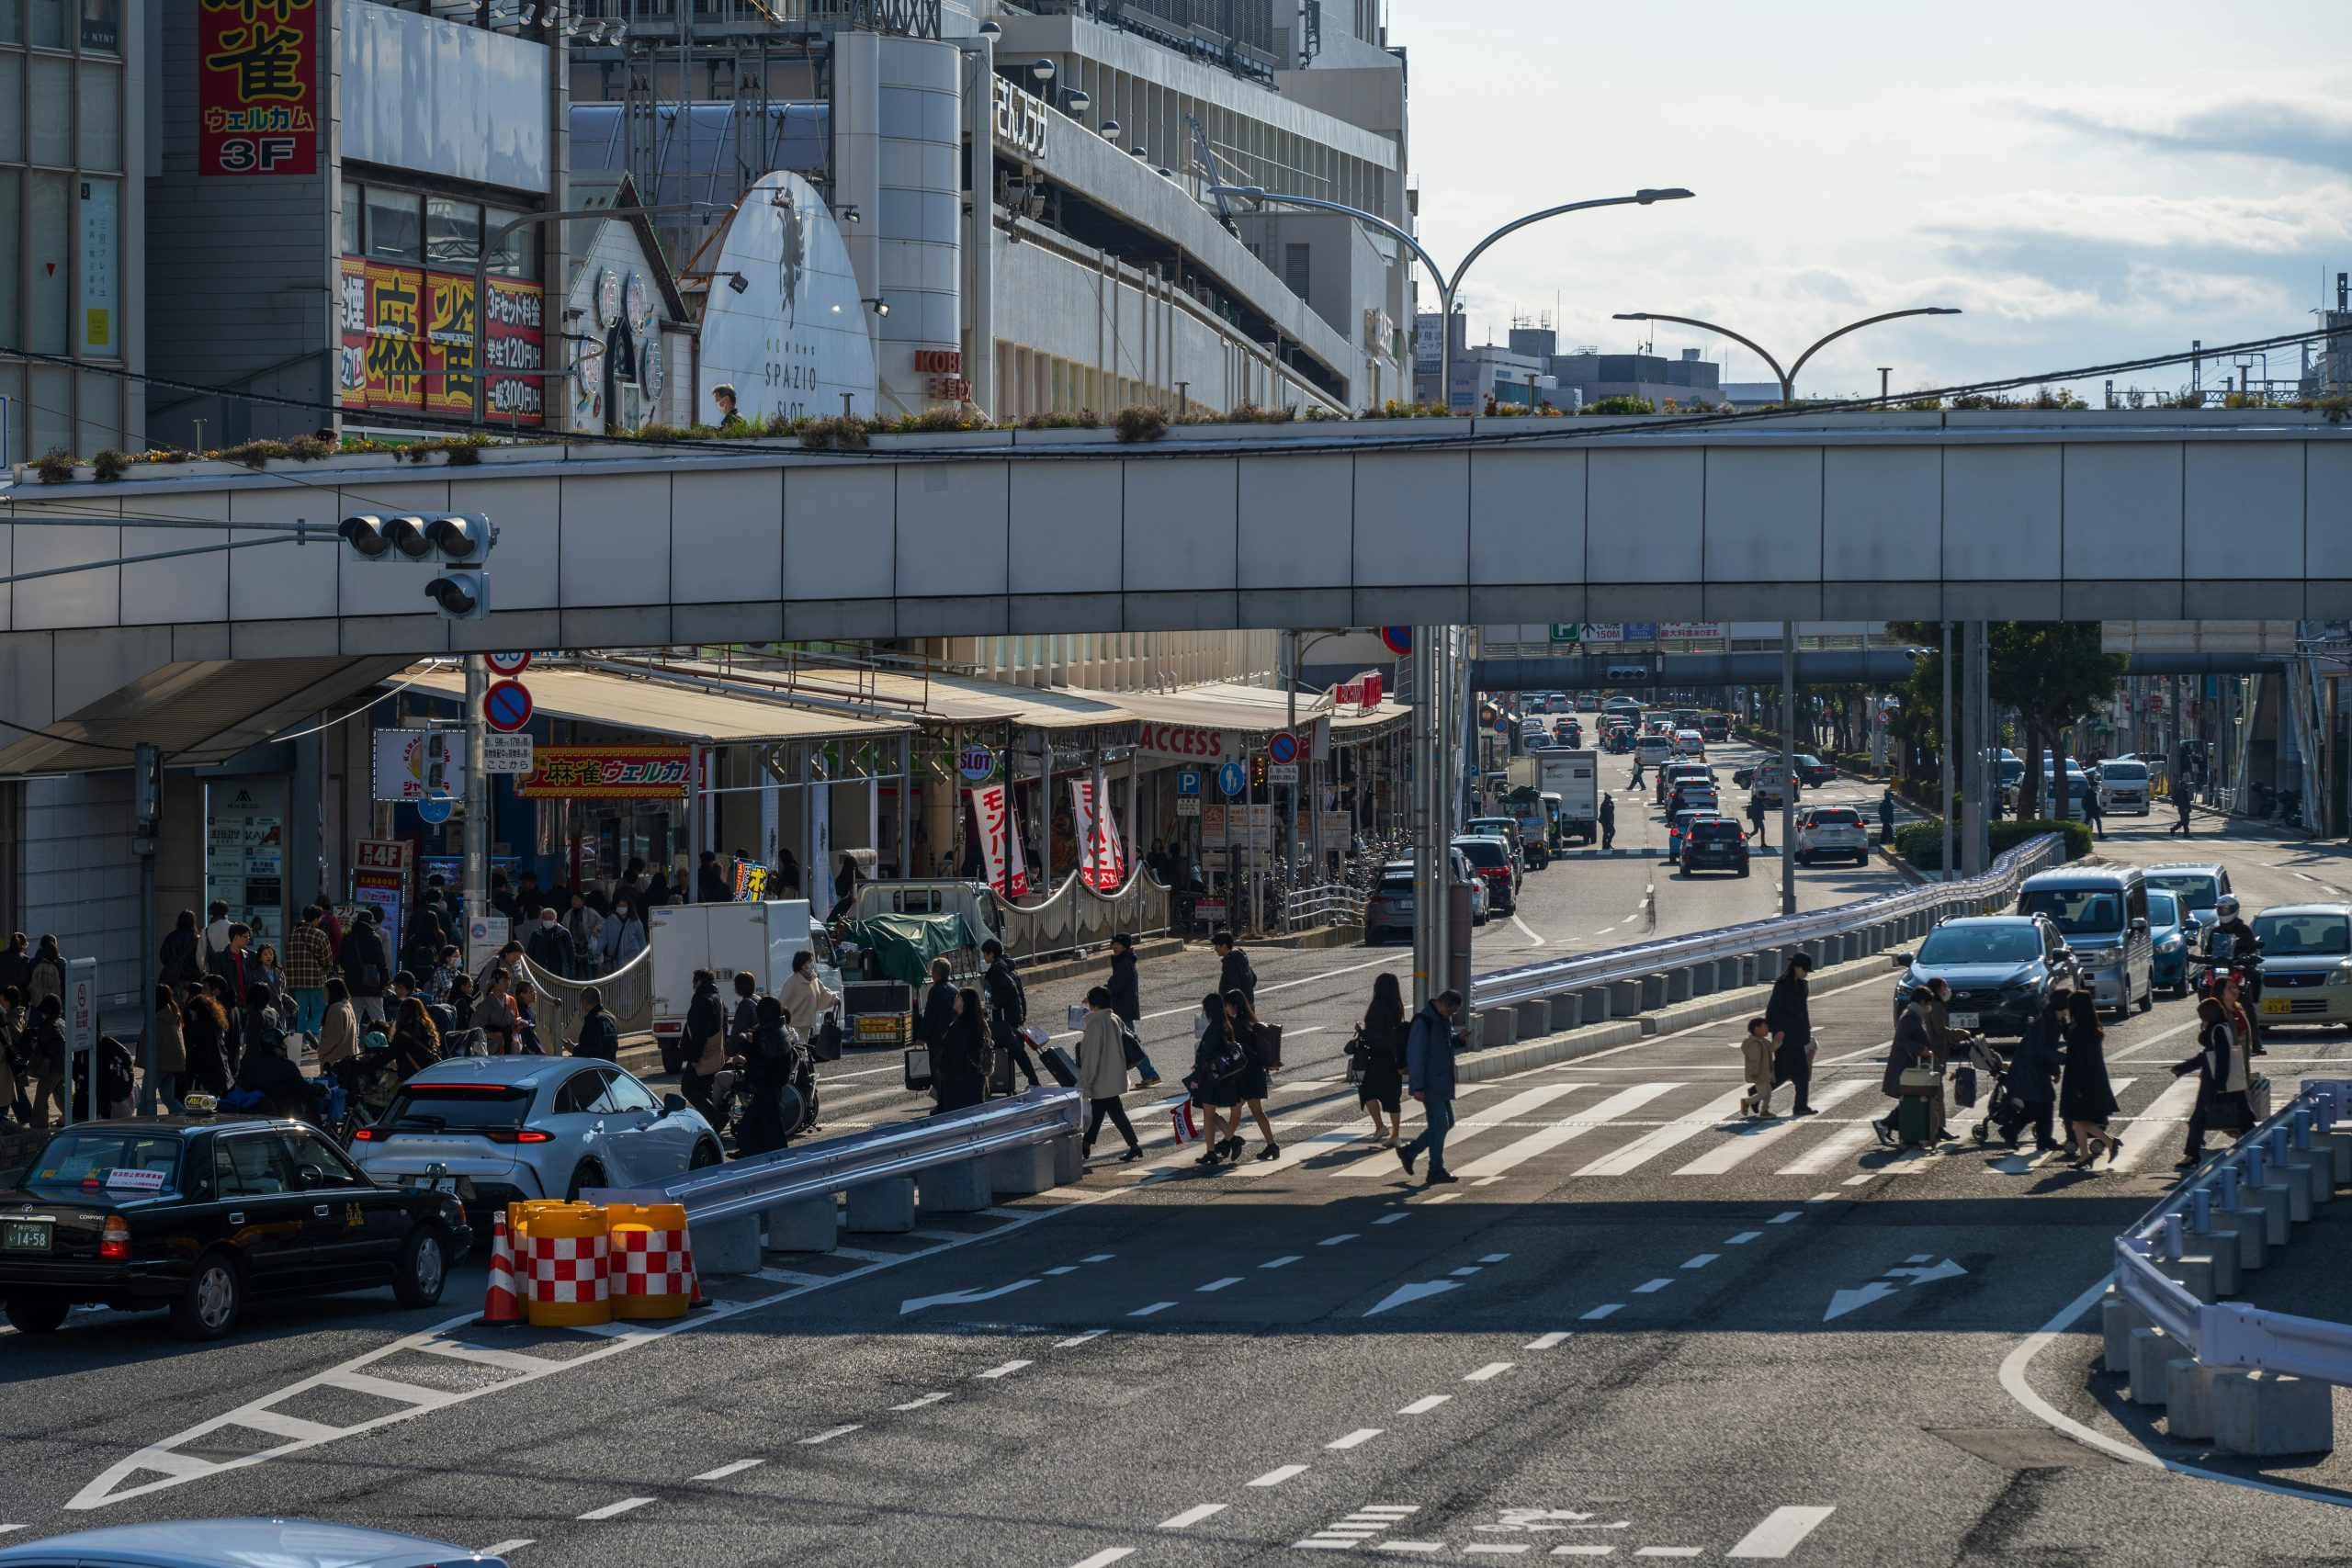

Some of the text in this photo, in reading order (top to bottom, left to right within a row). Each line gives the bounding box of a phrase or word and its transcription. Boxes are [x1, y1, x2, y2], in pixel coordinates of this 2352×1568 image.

[92, 32, 115, 43] NYNY
[205, 105, 315, 133] ウェルカム
[220, 138, 296, 172] 3F
[488, 286, 541, 327] 3Fセット料金
[368, 269, 473, 405] 麻雀
[487, 339, 540, 369] 学生120円/H
[765, 362, 816, 390] SPAZIO
[488, 379, 540, 411] 一般300円/H
[777, 400, 805, 422] SLOT
[1596, 630, 1621, 639] 150M
[1139, 724, 1221, 757] ACCESS
[487, 760, 528, 770] ここから
[960, 753, 992, 771] SLOT
[1182, 773, 1196, 792] P
[374, 845, 398, 866] 4F
[17, 1233, 46, 1247] 14-58
